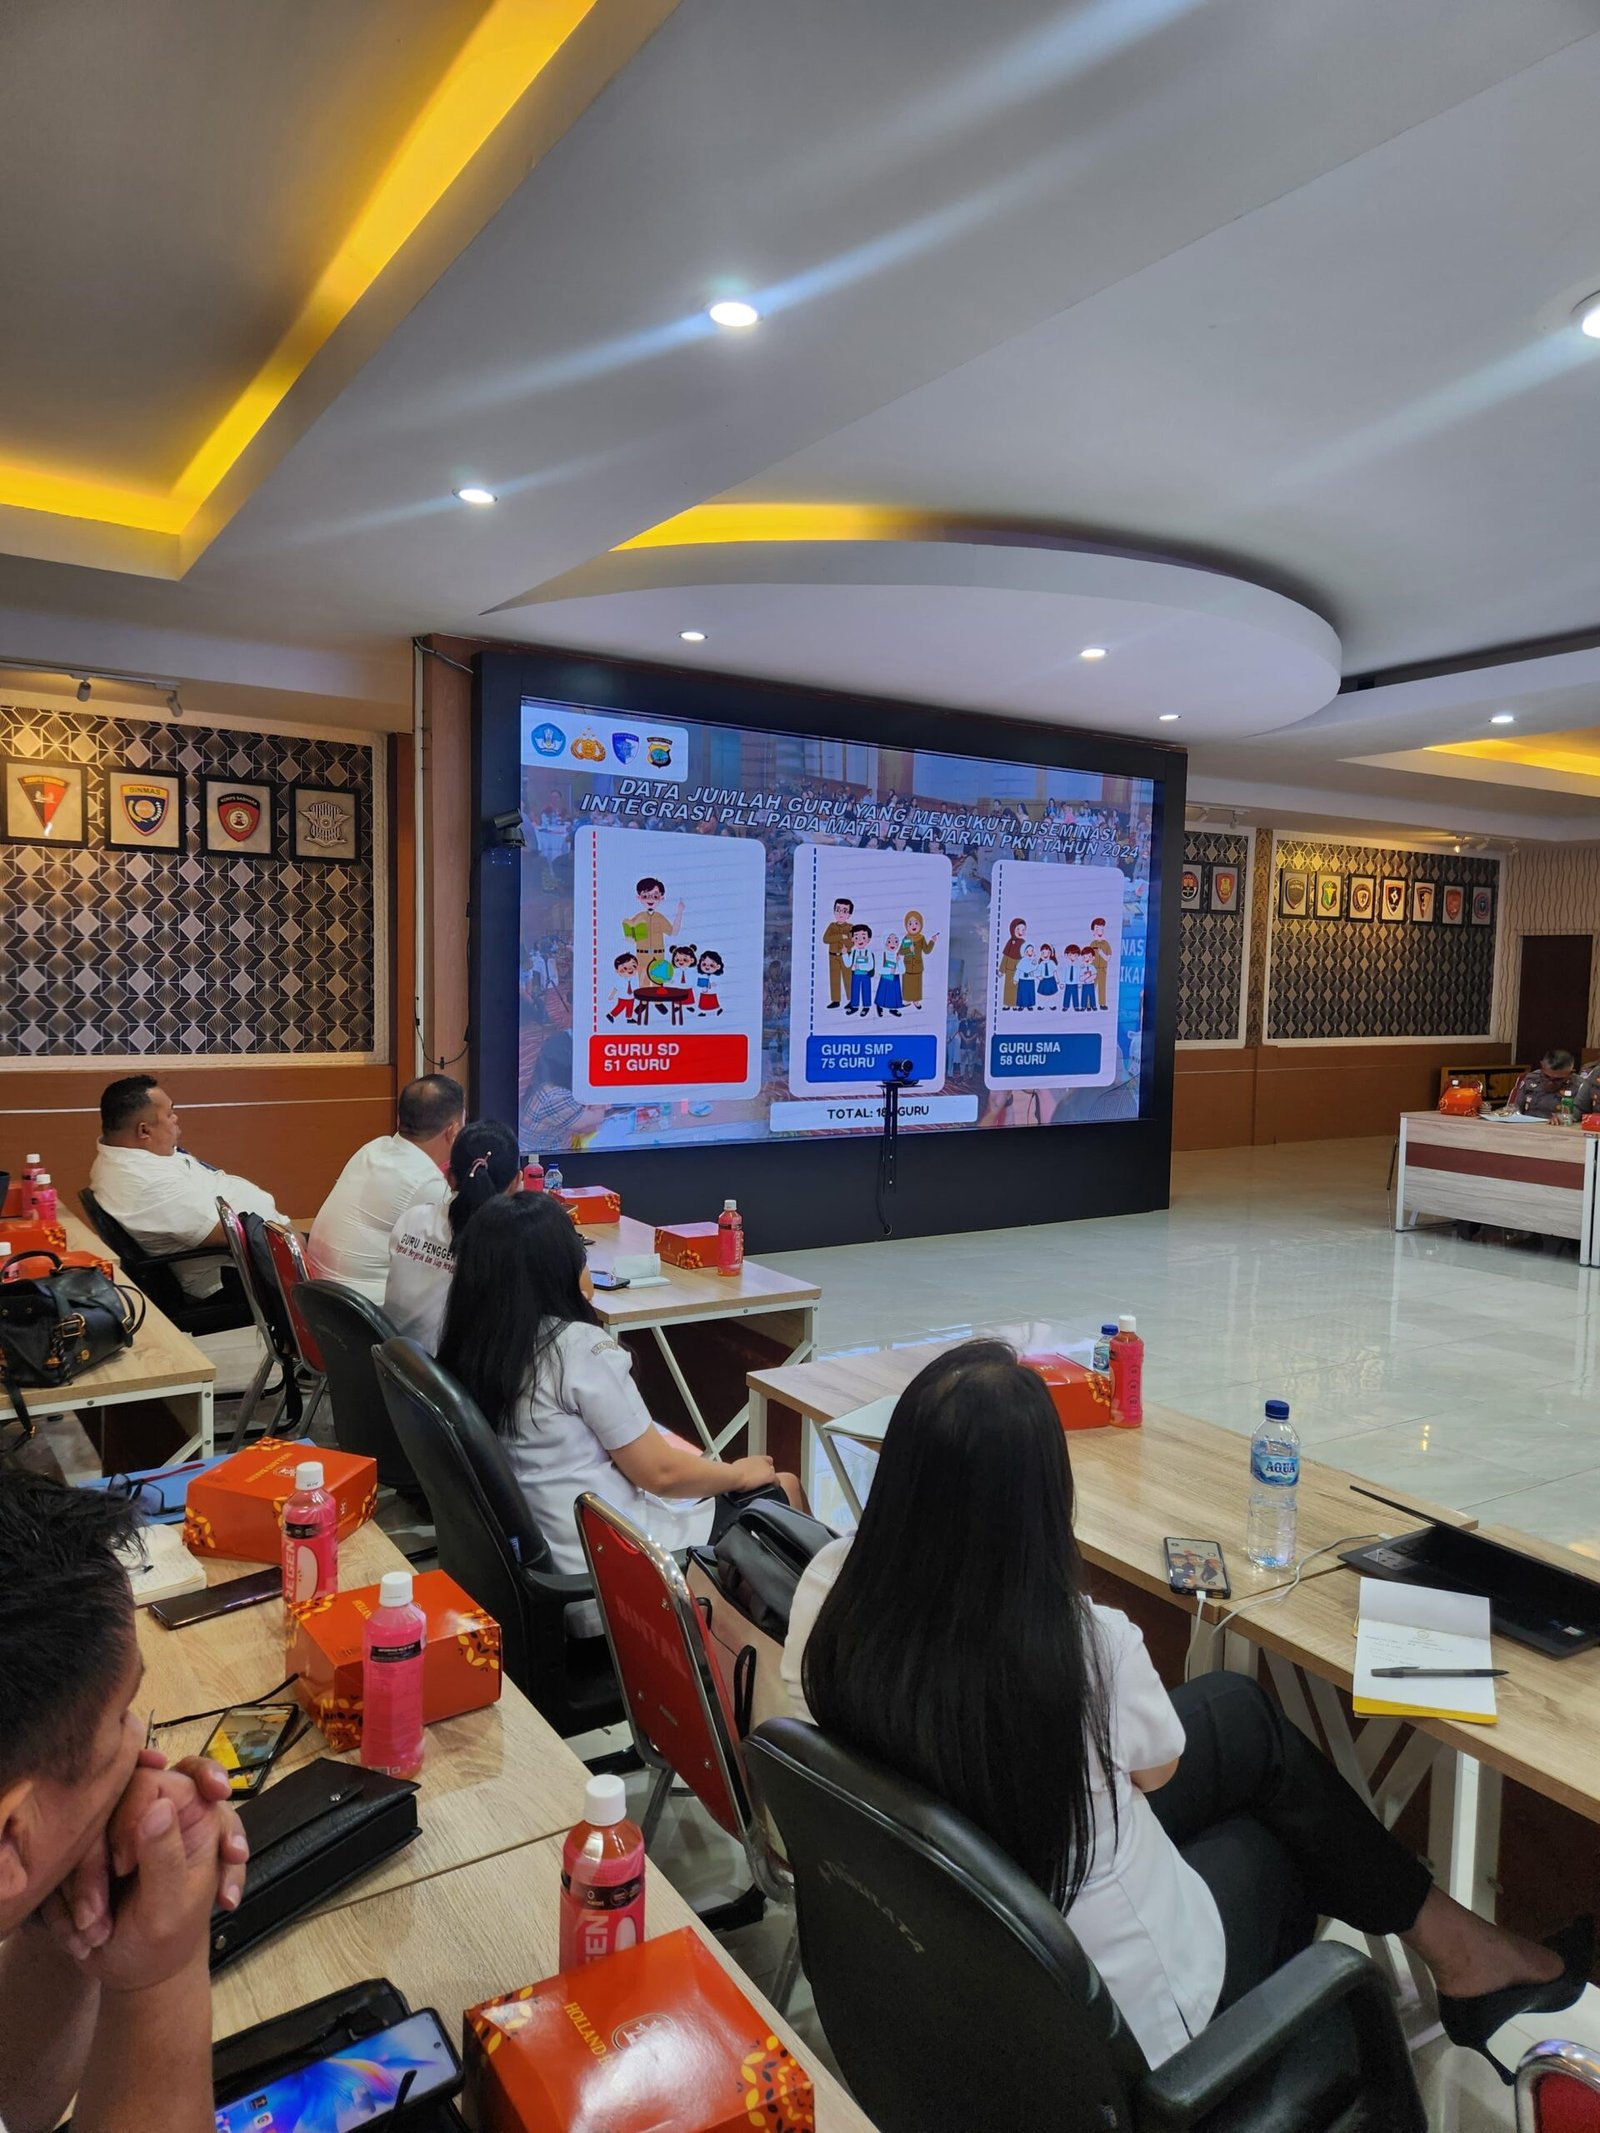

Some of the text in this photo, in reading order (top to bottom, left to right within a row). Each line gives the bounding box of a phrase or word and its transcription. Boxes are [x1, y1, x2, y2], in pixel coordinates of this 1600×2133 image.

[620, 779, 1117, 842] DATA JUMLAH GURU YANG MENGIKUTI DISEMINASI
[580, 794, 1140, 858] INTEGRASI PLL PADA MATA PELAJARAN PKN TAHUN 2024
[604, 1043, 680, 1057] GURU SD
[821, 1043, 893, 1056] GURU SMP
[999, 1042, 1061, 1054] GURU SMA
[604, 1058, 671, 1072] 51 GURU
[821, 1057, 875, 1069] 75 GURU
[1000, 1054, 1046, 1066] 58 GURU
[827, 1108, 873, 1119] TOTAL:
[897, 1105, 929, 1117] GURU
[400, 1233, 421, 1249] GURU
[1265, 1461, 1296, 1475] AQUA
[585, 1915, 609, 1963] EN
[564, 2002, 607, 2056] HOLLAND
